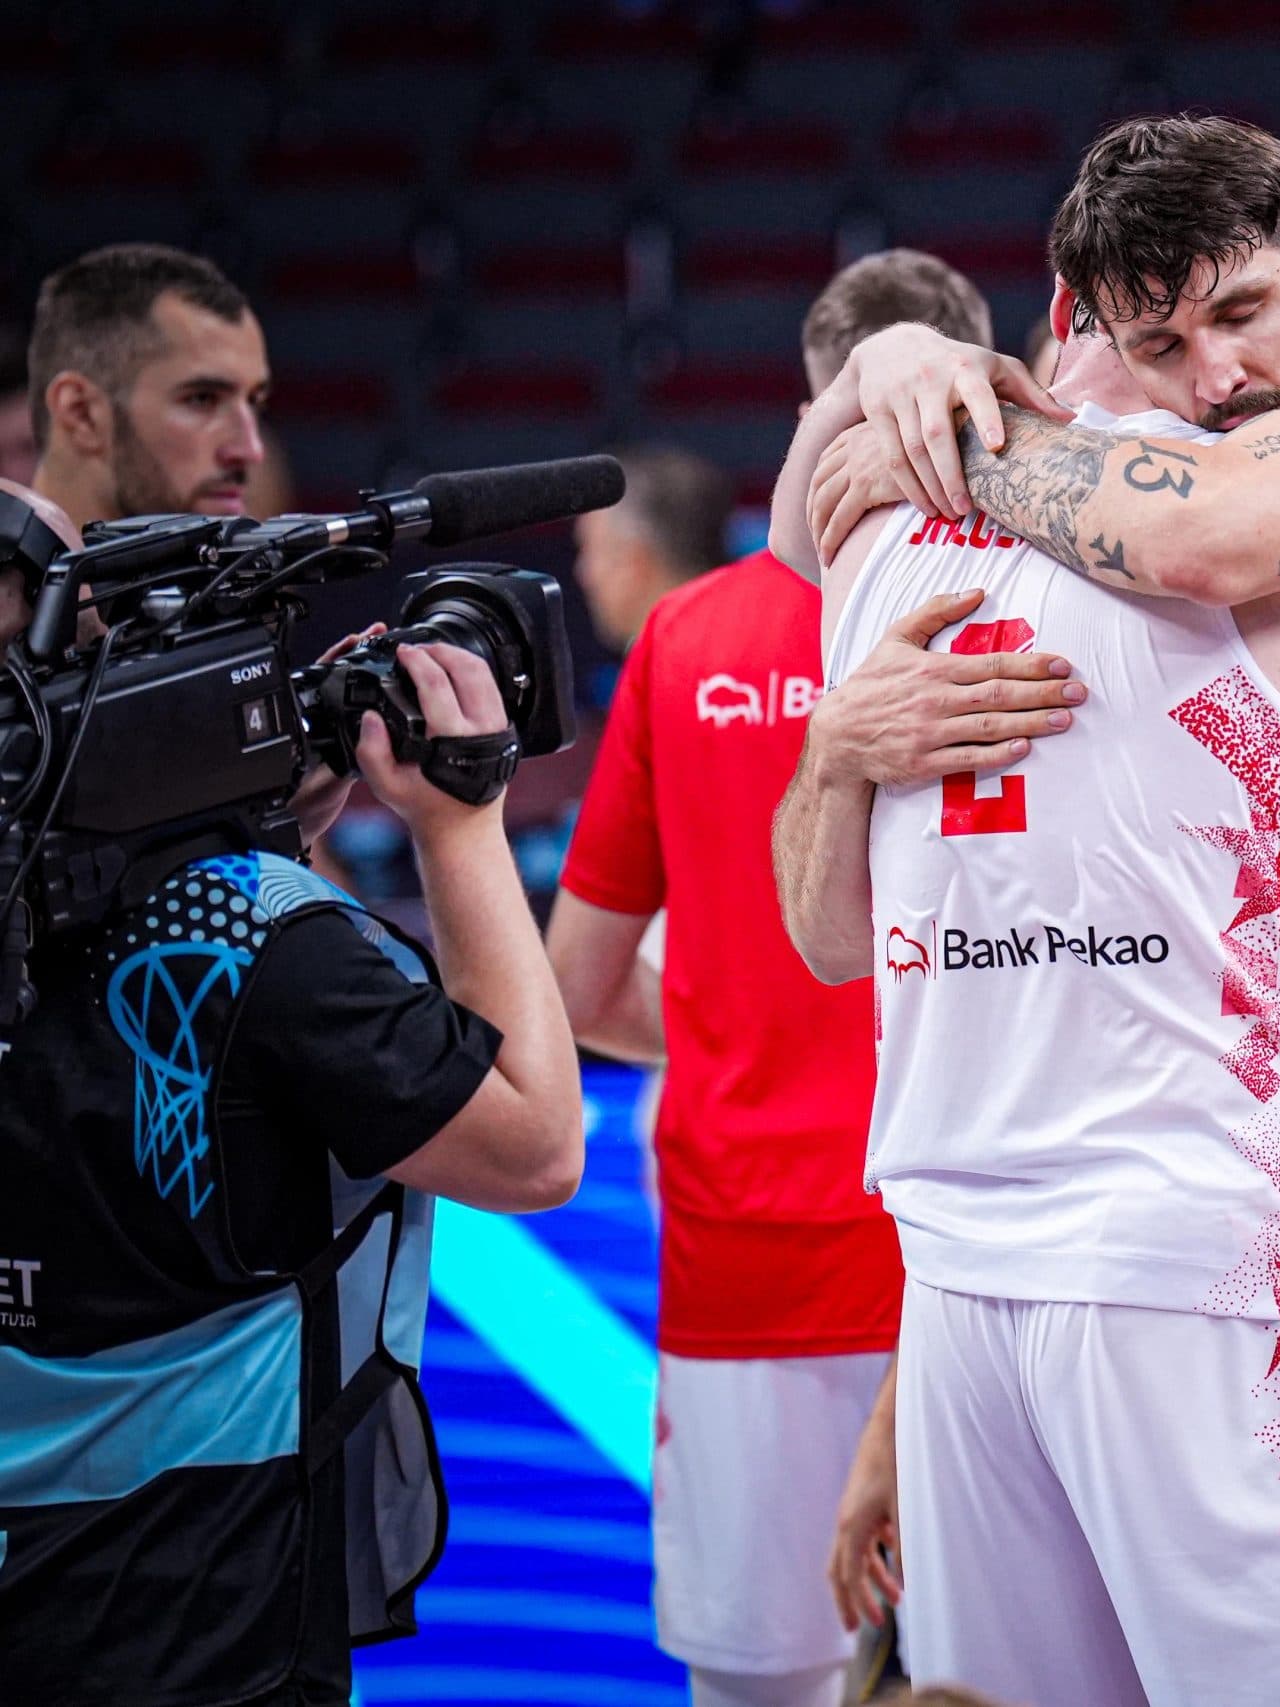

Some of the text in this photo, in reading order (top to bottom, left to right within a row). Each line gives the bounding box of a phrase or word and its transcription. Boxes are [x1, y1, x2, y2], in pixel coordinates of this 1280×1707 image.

[1124, 440, 1198, 498] 13
[231, 661, 271, 684] SONY
[783, 676, 825, 718] B
[250, 708, 262, 731] 4
[943, 925, 1169, 970] Bank Pekao
